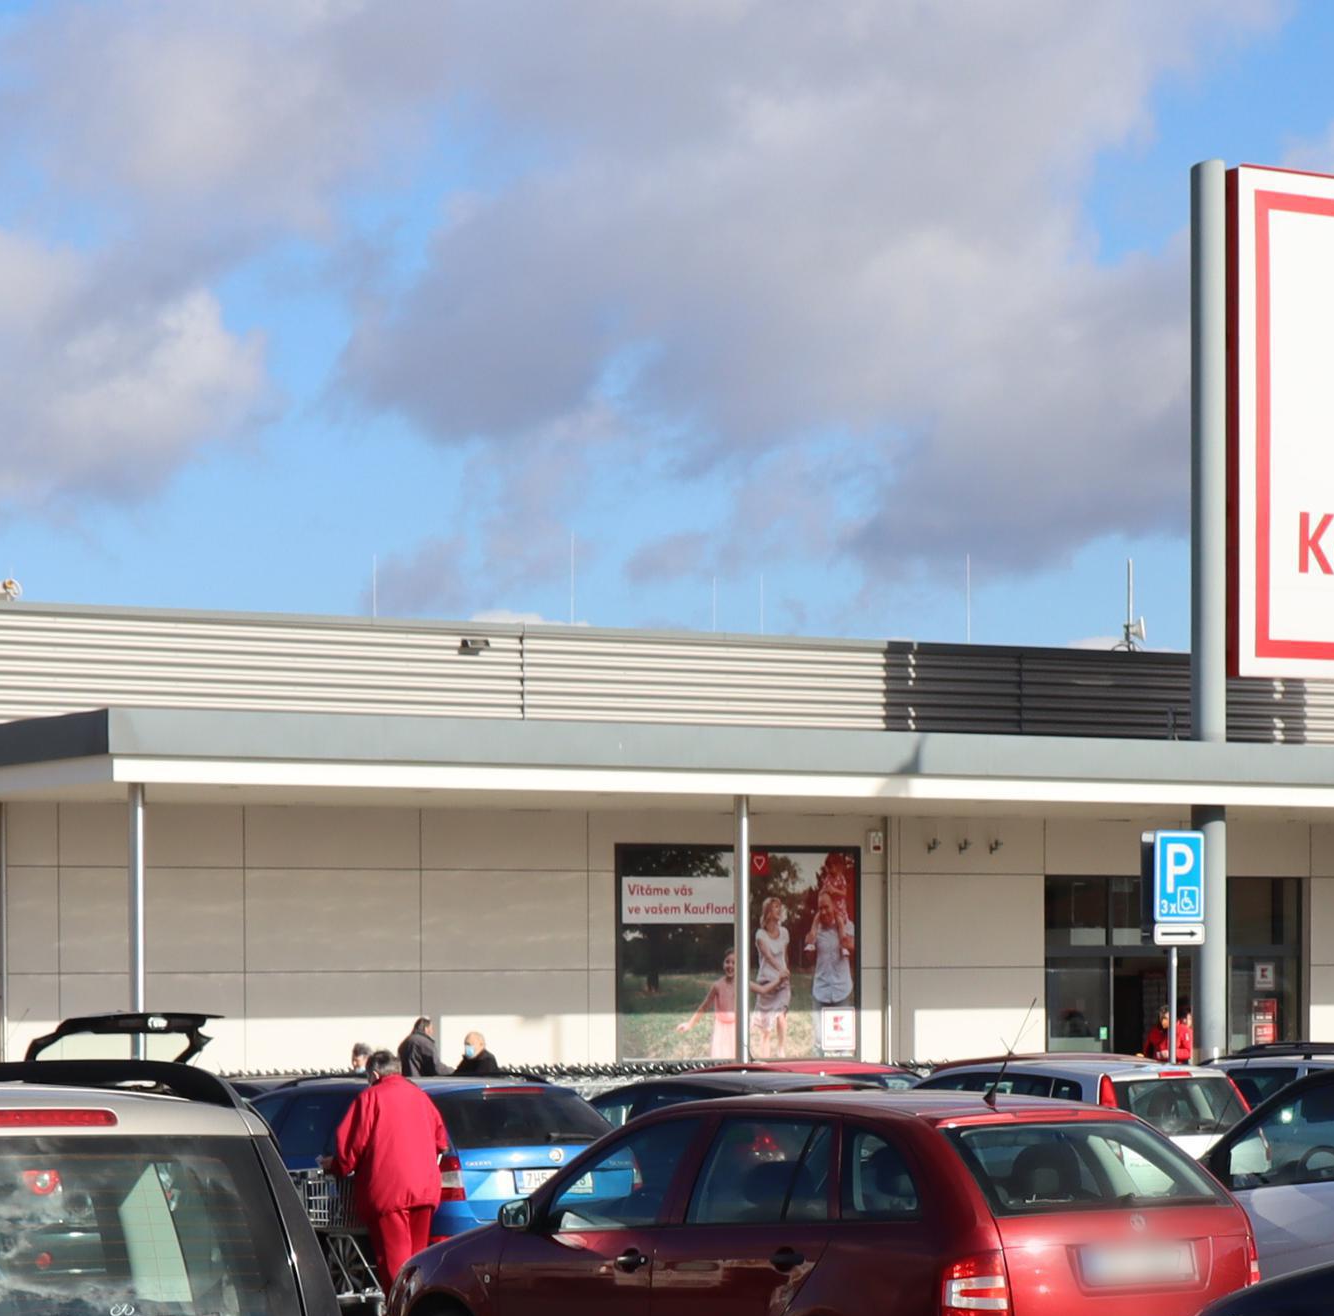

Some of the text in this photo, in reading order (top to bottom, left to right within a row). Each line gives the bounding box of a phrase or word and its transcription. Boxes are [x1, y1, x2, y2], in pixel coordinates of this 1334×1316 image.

[1166, 843, 1194, 894] P
[628, 884, 693, 896] Vítáme vás
[628, 903, 736, 915] ve vašem Kaufland
